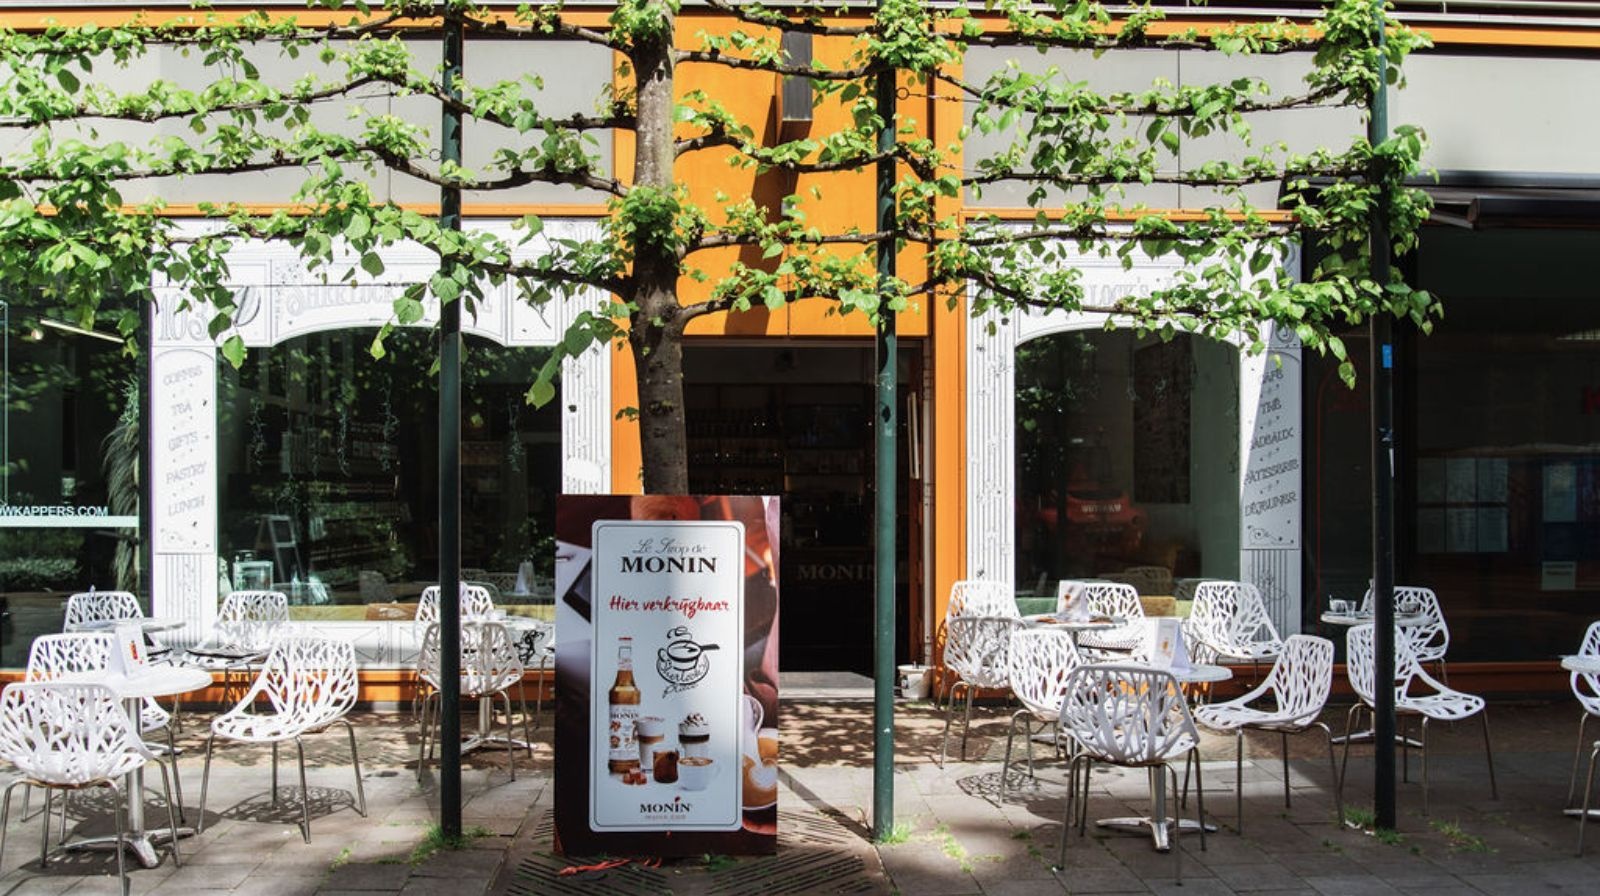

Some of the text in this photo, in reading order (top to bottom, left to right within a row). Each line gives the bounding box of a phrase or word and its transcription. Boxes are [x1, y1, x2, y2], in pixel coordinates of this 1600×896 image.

[171, 401, 193, 416] TEA
[168, 431, 200, 452] GIFTS
[166, 461, 207, 485] PASTRY
[0, 505, 109, 517] WKAPPERS.COM
[168, 494, 205, 517] LUNCH
[632, 538, 653, 554] Le
[655, 537, 690, 556] Sirop
[620, 556, 717, 573] MONIN
[609, 595, 729, 620] Hier verkrijgbaar
[640, 798, 690, 813] MONIN
